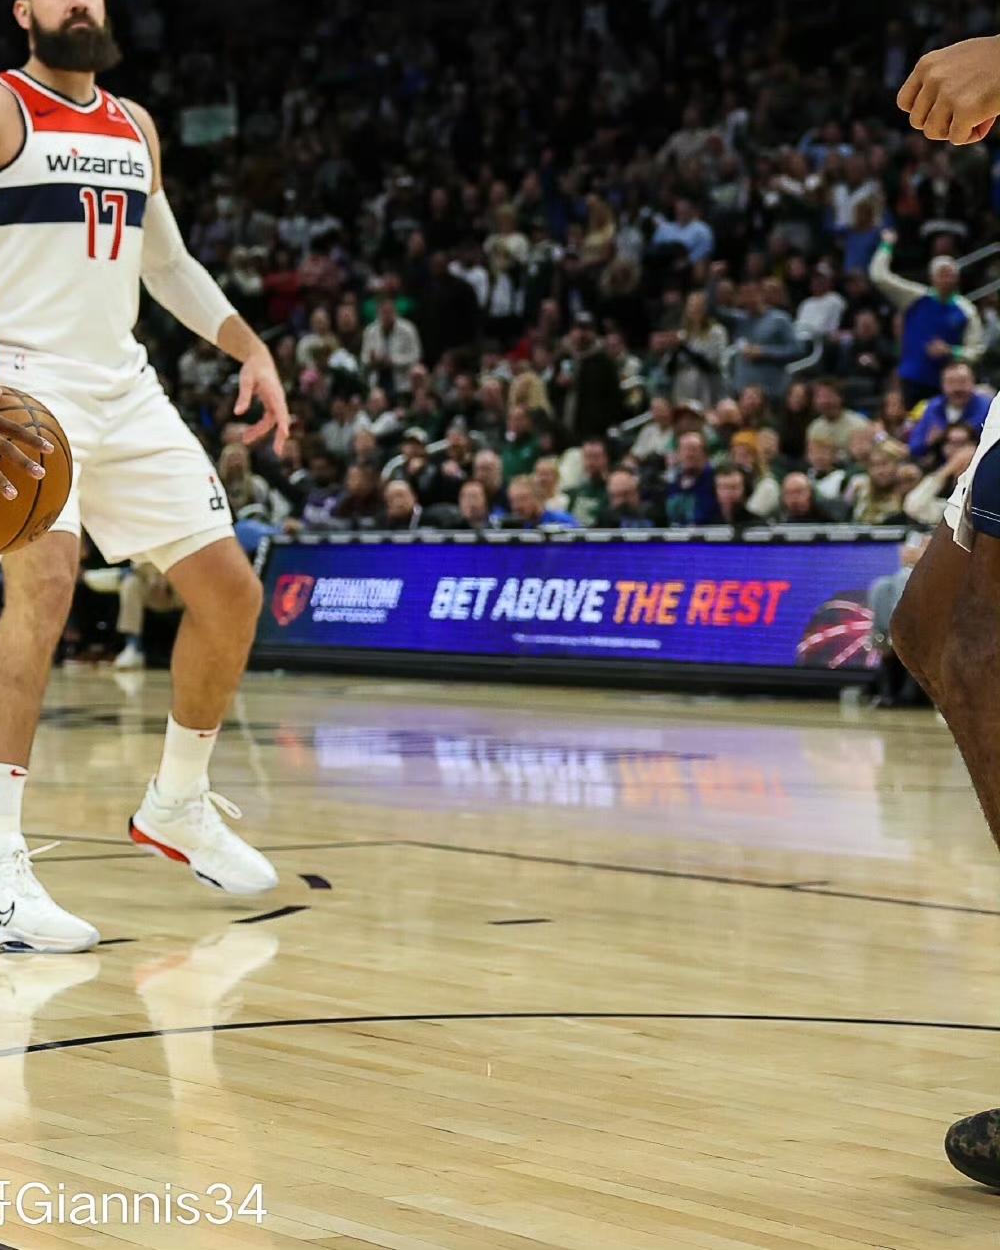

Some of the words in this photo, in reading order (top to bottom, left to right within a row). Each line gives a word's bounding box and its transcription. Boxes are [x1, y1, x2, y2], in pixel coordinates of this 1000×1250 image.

[79, 187, 128, 261] 17
[429, 577, 498, 620] BET
[490, 578, 611, 623] ABOVE
[613, 580, 685, 625] THE
[686, 579, 791, 626] REST
